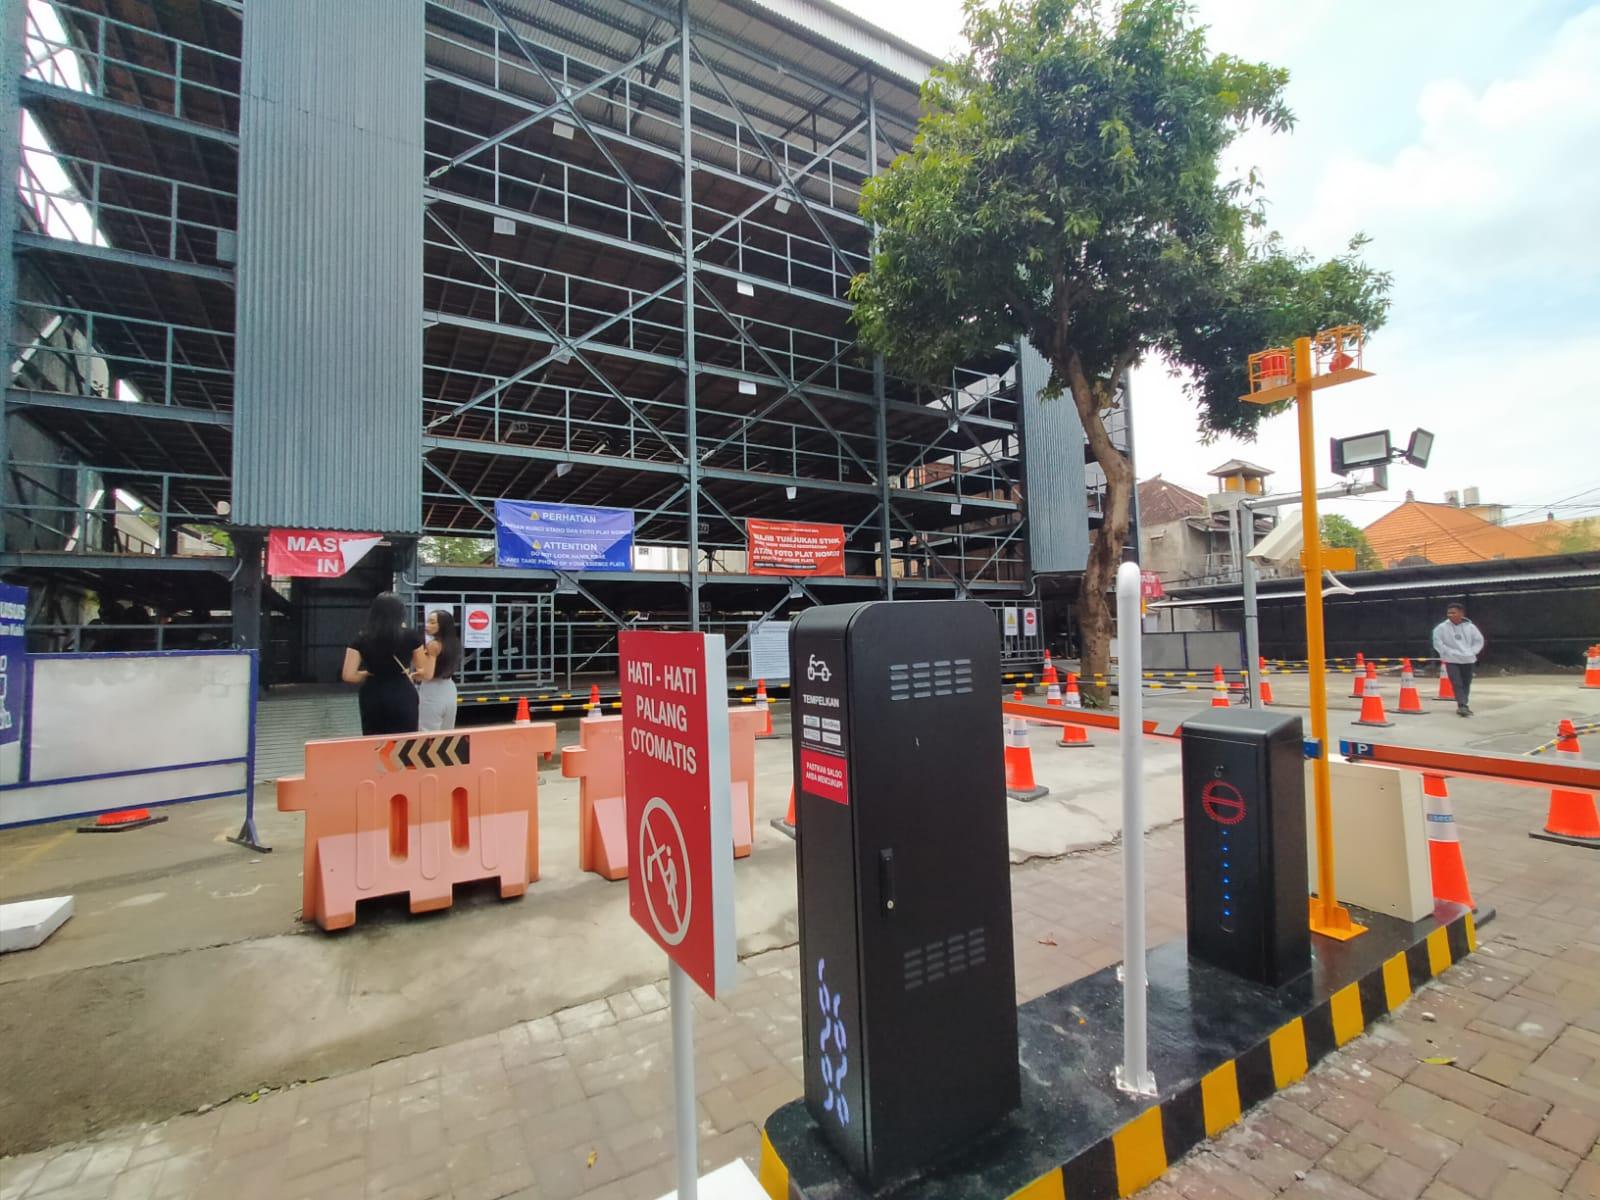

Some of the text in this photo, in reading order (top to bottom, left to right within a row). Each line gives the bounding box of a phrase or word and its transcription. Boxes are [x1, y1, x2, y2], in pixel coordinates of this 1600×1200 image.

[542, 511, 597, 523] PERHATIAN
[543, 541, 598, 551] ATTENTION
[775, 535, 818, 544] TUNJUKAN
[774, 549, 794, 557] FOTO
[795, 550, 813, 558] PLAT
[317, 558, 339, 573] IN
[627, 660, 653, 687] HATI
[664, 664, 697, 695] HATI
[803, 693, 840, 708] TEMPELKAN
[636, 694, 688, 732] PALANG
[631, 727, 697, 775] OTOMATIS
[1357, 743, 1368, 754] P
